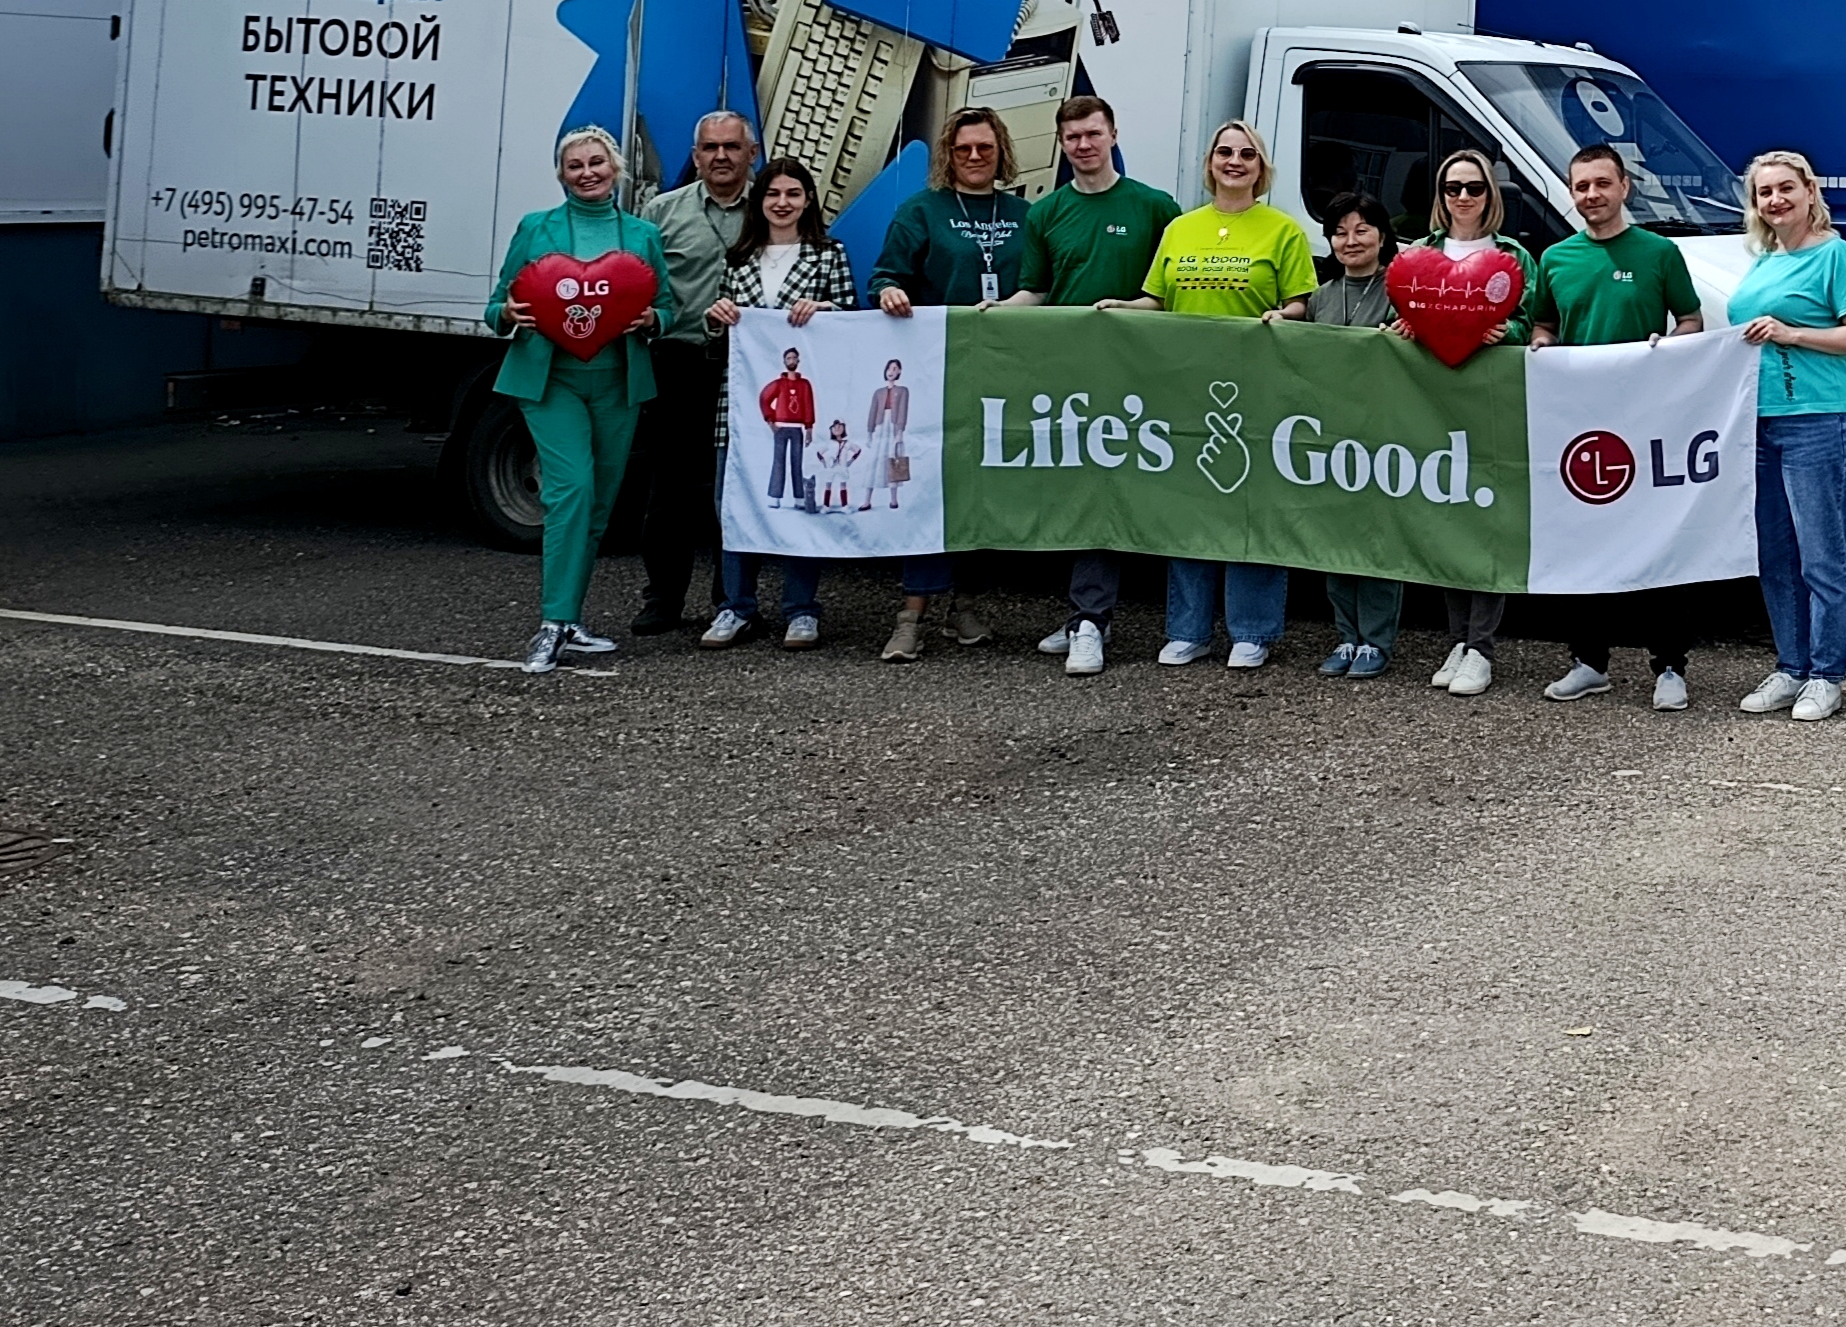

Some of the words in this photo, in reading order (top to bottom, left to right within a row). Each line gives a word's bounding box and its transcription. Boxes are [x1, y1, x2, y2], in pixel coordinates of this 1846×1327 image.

[242, 14, 440, 61] БЫТОВОЙ
[245, 73, 435, 120] ТЕХНИКИ
[151, 187, 177, 212] +7
[180, 189, 233, 223] (495)
[239, 193, 354, 225] 995-47-54
[949, 218, 971, 228] Los
[974, 219, 1019, 231] Angeles
[183, 228, 352, 259] petromaxi.com
[584, 280, 610, 297] LG
[1435, 303, 1496, 311] CHAPURIN
[980, 392, 1175, 471] Life's
[1271, 413, 1495, 508] Good.
[1651, 429, 1720, 488] LG
